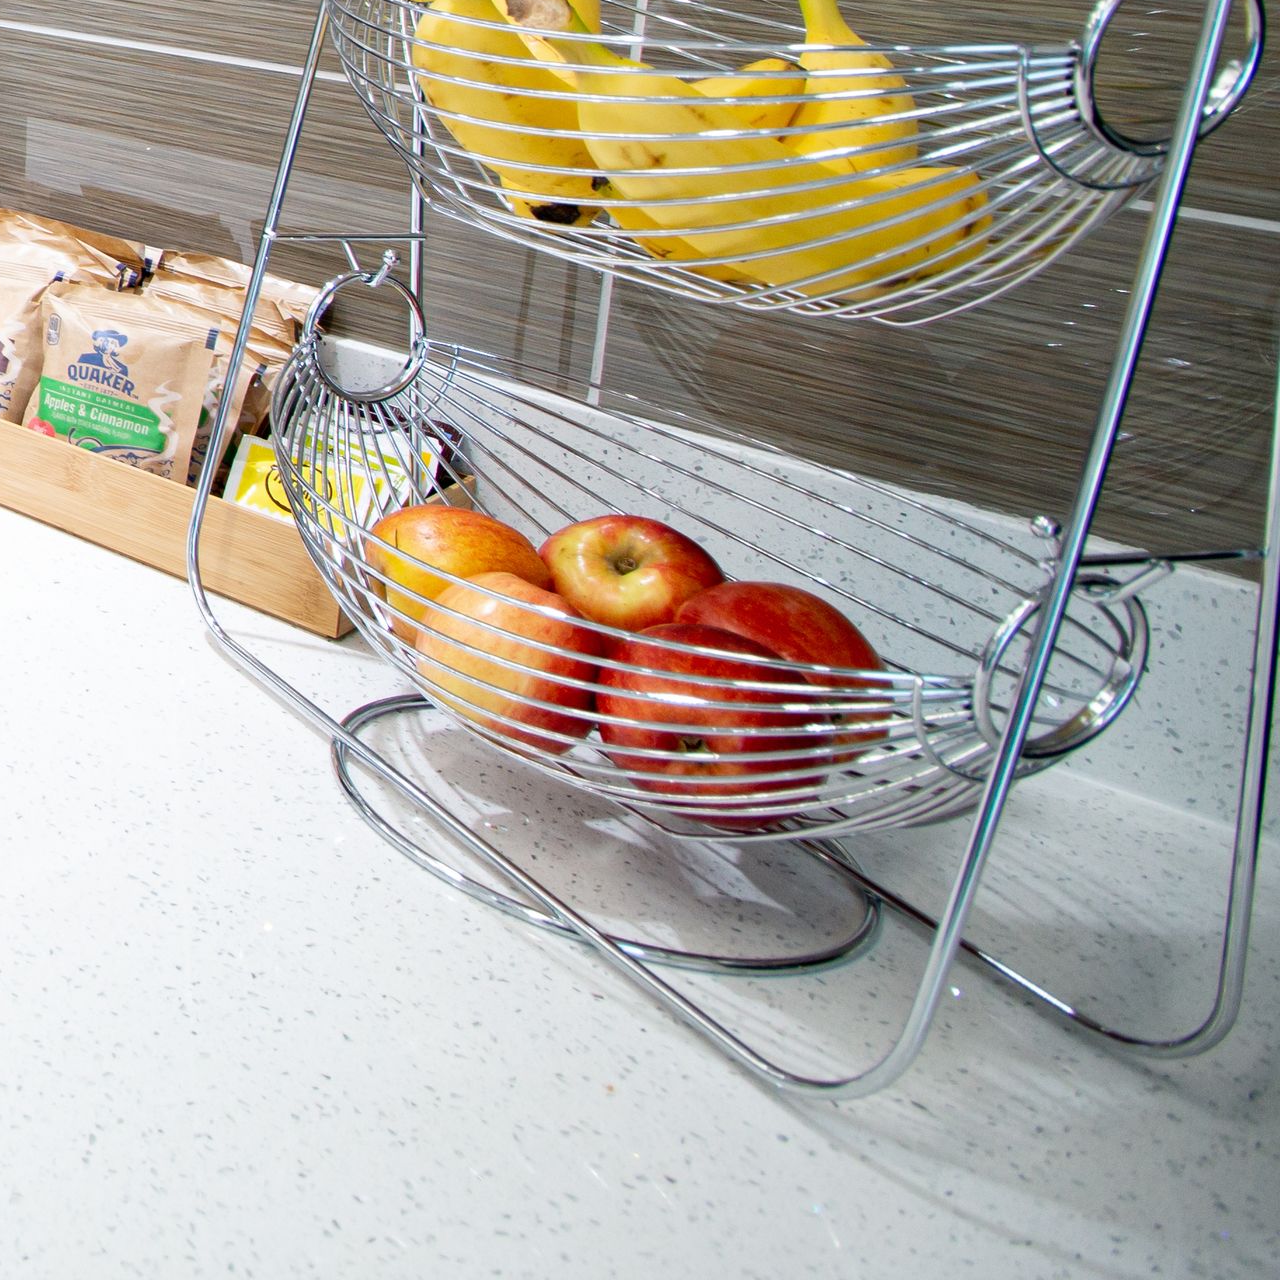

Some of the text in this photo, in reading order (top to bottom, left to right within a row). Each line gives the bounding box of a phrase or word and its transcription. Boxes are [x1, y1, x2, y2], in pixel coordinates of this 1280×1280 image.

[67, 364, 135, 397] QUAKER
[44, 393, 149, 435] Apples & Cinnamon
[59, 385, 91, 399] INSTANT
[95, 395, 136, 412] OATMEAL
